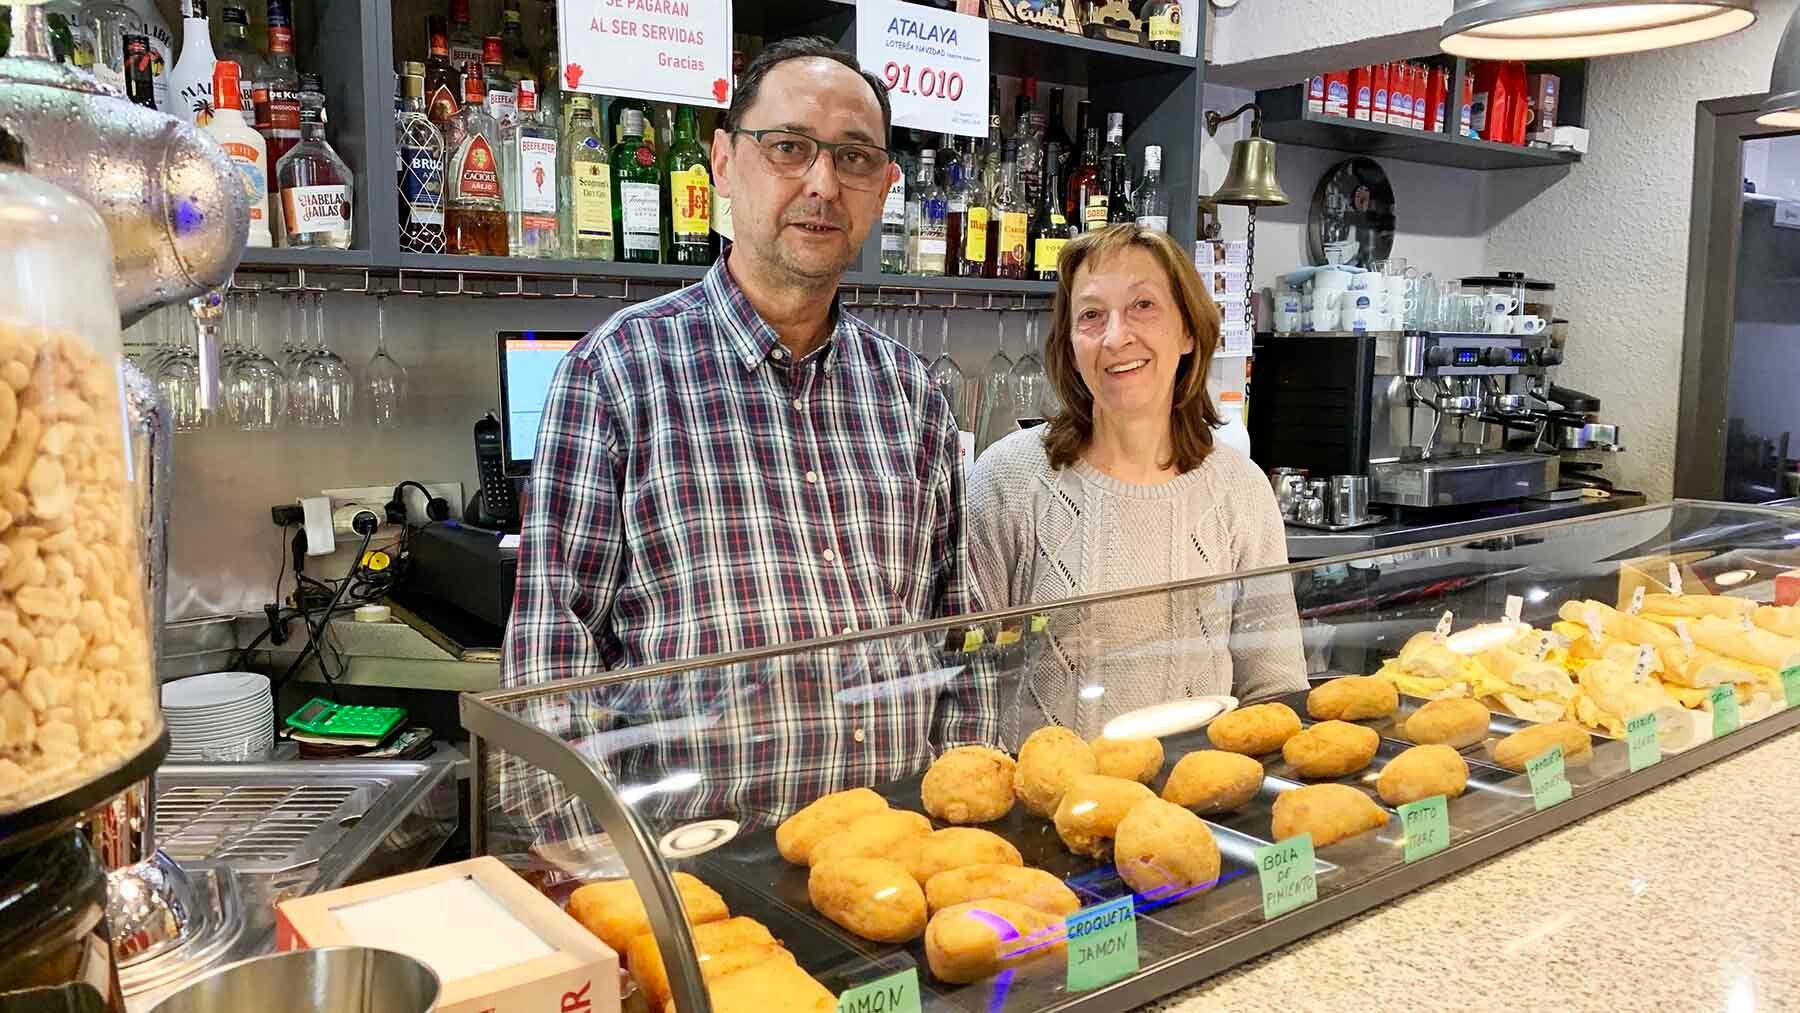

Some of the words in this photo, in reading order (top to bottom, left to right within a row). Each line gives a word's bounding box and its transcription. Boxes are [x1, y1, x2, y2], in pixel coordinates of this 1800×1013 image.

[590, 17, 607, 33] AL
[611, 19, 638, 37] SER
[641, 23, 704, 46] SERVIDAS
[887, 17, 958, 46] ATALAYA
[658, 52, 705, 72] Gracias
[883, 61, 963, 101] 91.010
[522, 140, 556, 153] BEEFEATER
[463, 172, 497, 182] CACIQUE
[1263, 847, 1298, 871] BOLA
[1265, 874, 1313, 909] PIMIENTO
[1067, 905, 1133, 939] CROQUETA
[1078, 930, 1128, 965] JAMON
